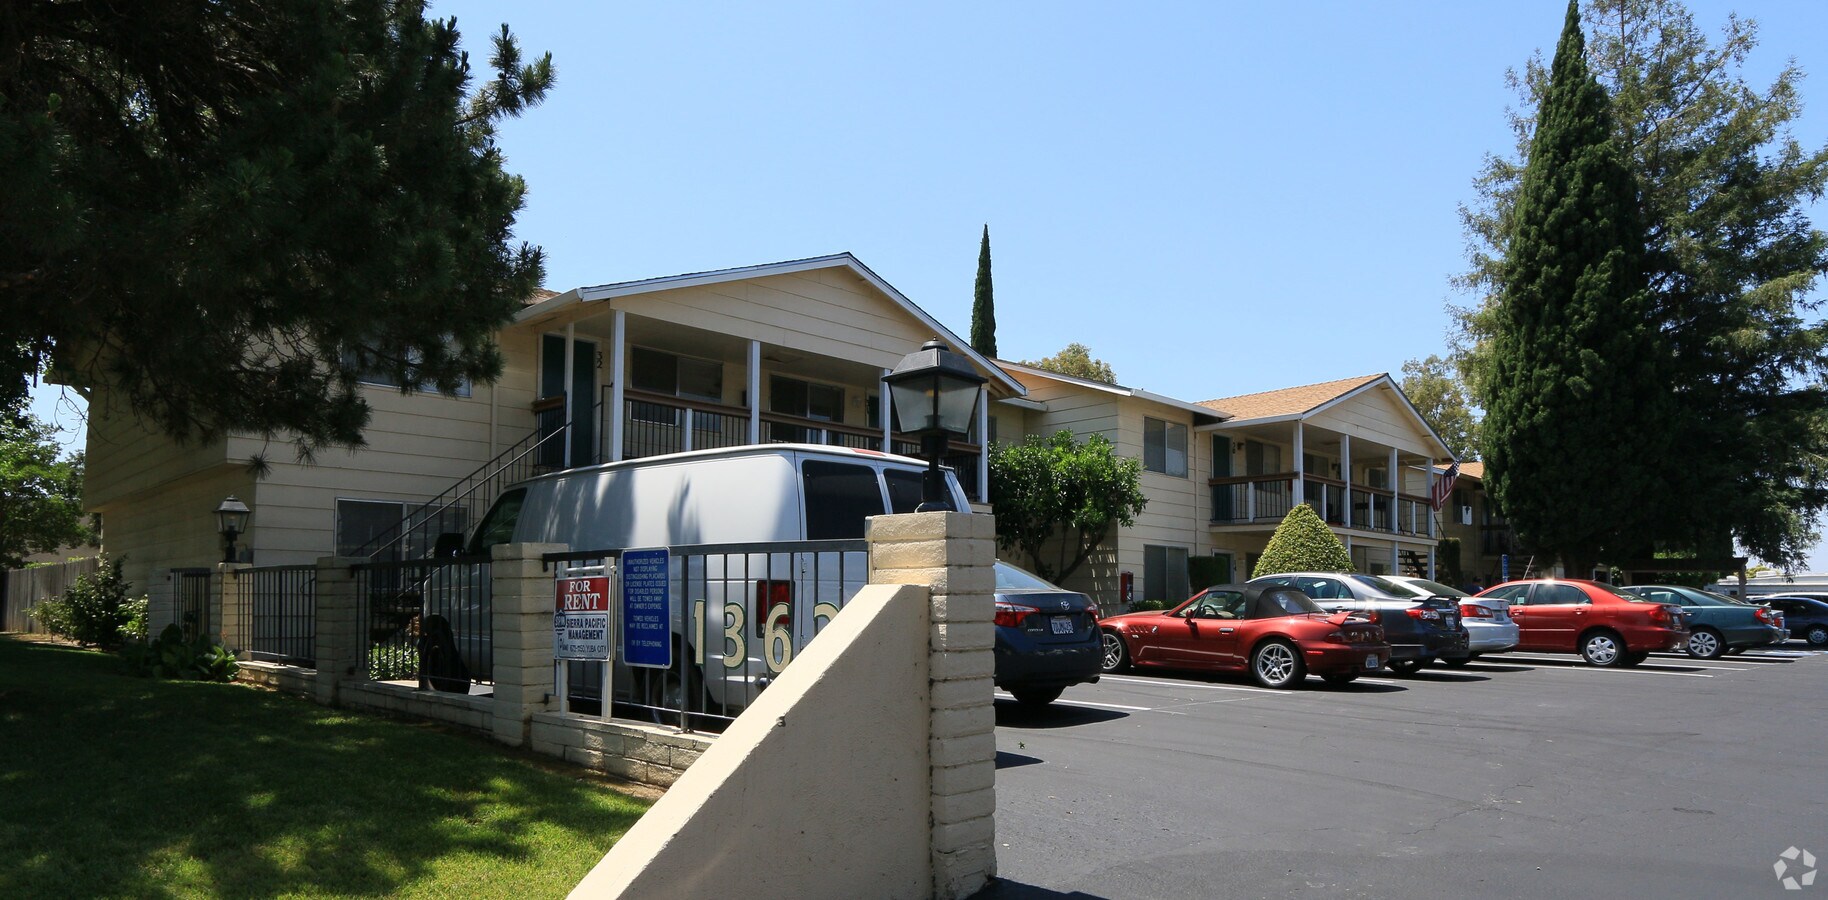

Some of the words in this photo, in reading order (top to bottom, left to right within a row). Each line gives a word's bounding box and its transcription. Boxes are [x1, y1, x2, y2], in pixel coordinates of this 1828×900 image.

[569, 580, 591, 592] FOR
[564, 593, 600, 610] RENT
[566, 618, 584, 628] SIERRA
[585, 618, 606, 628] PACIFIC
[568, 630, 603, 640] MANAGEMENT
[586, 645, 596, 653] YUBA
[597, 645, 606, 653] CITY
